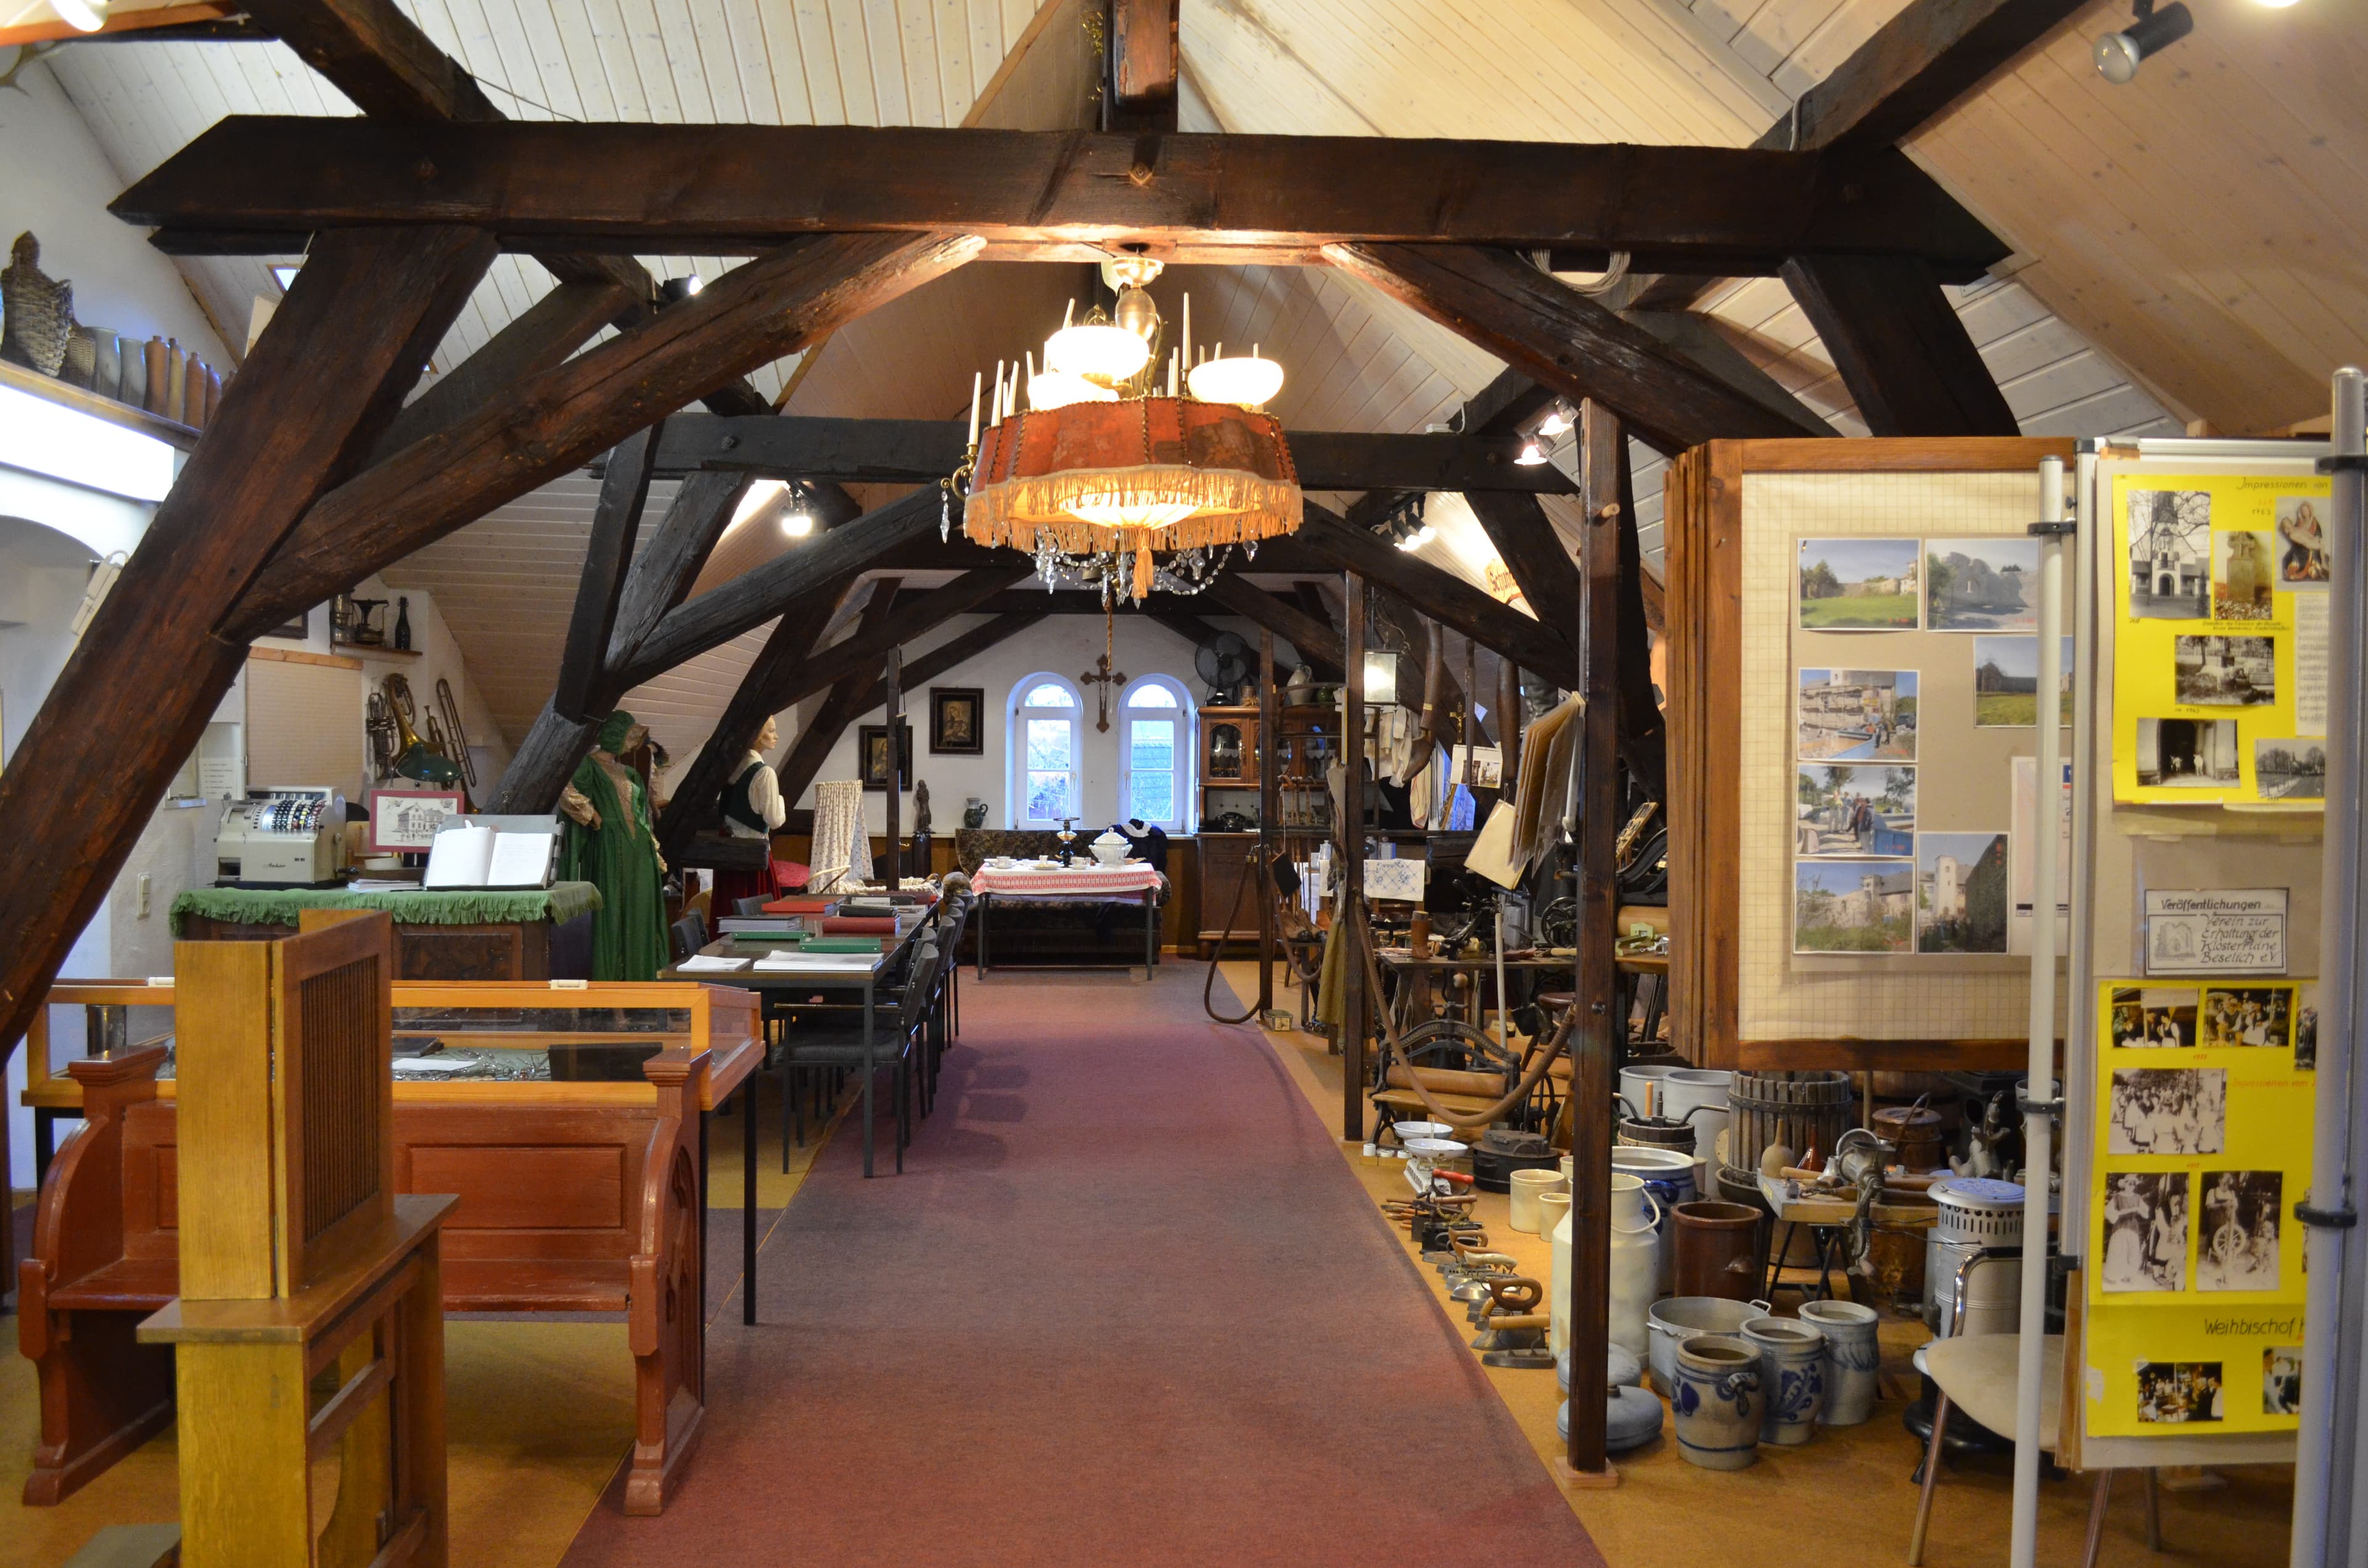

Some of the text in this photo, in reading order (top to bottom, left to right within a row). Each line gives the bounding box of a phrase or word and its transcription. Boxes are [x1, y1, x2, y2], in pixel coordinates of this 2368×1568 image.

[2161, 898, 2261, 912] Veröffentlichungen
[2200, 913, 2269, 926] Verein zur
[2202, 927, 2280, 942] Erhaltung der
[2200, 951, 2255, 964] Beselich
[2205, 1316, 2295, 1337] Weihbischof
